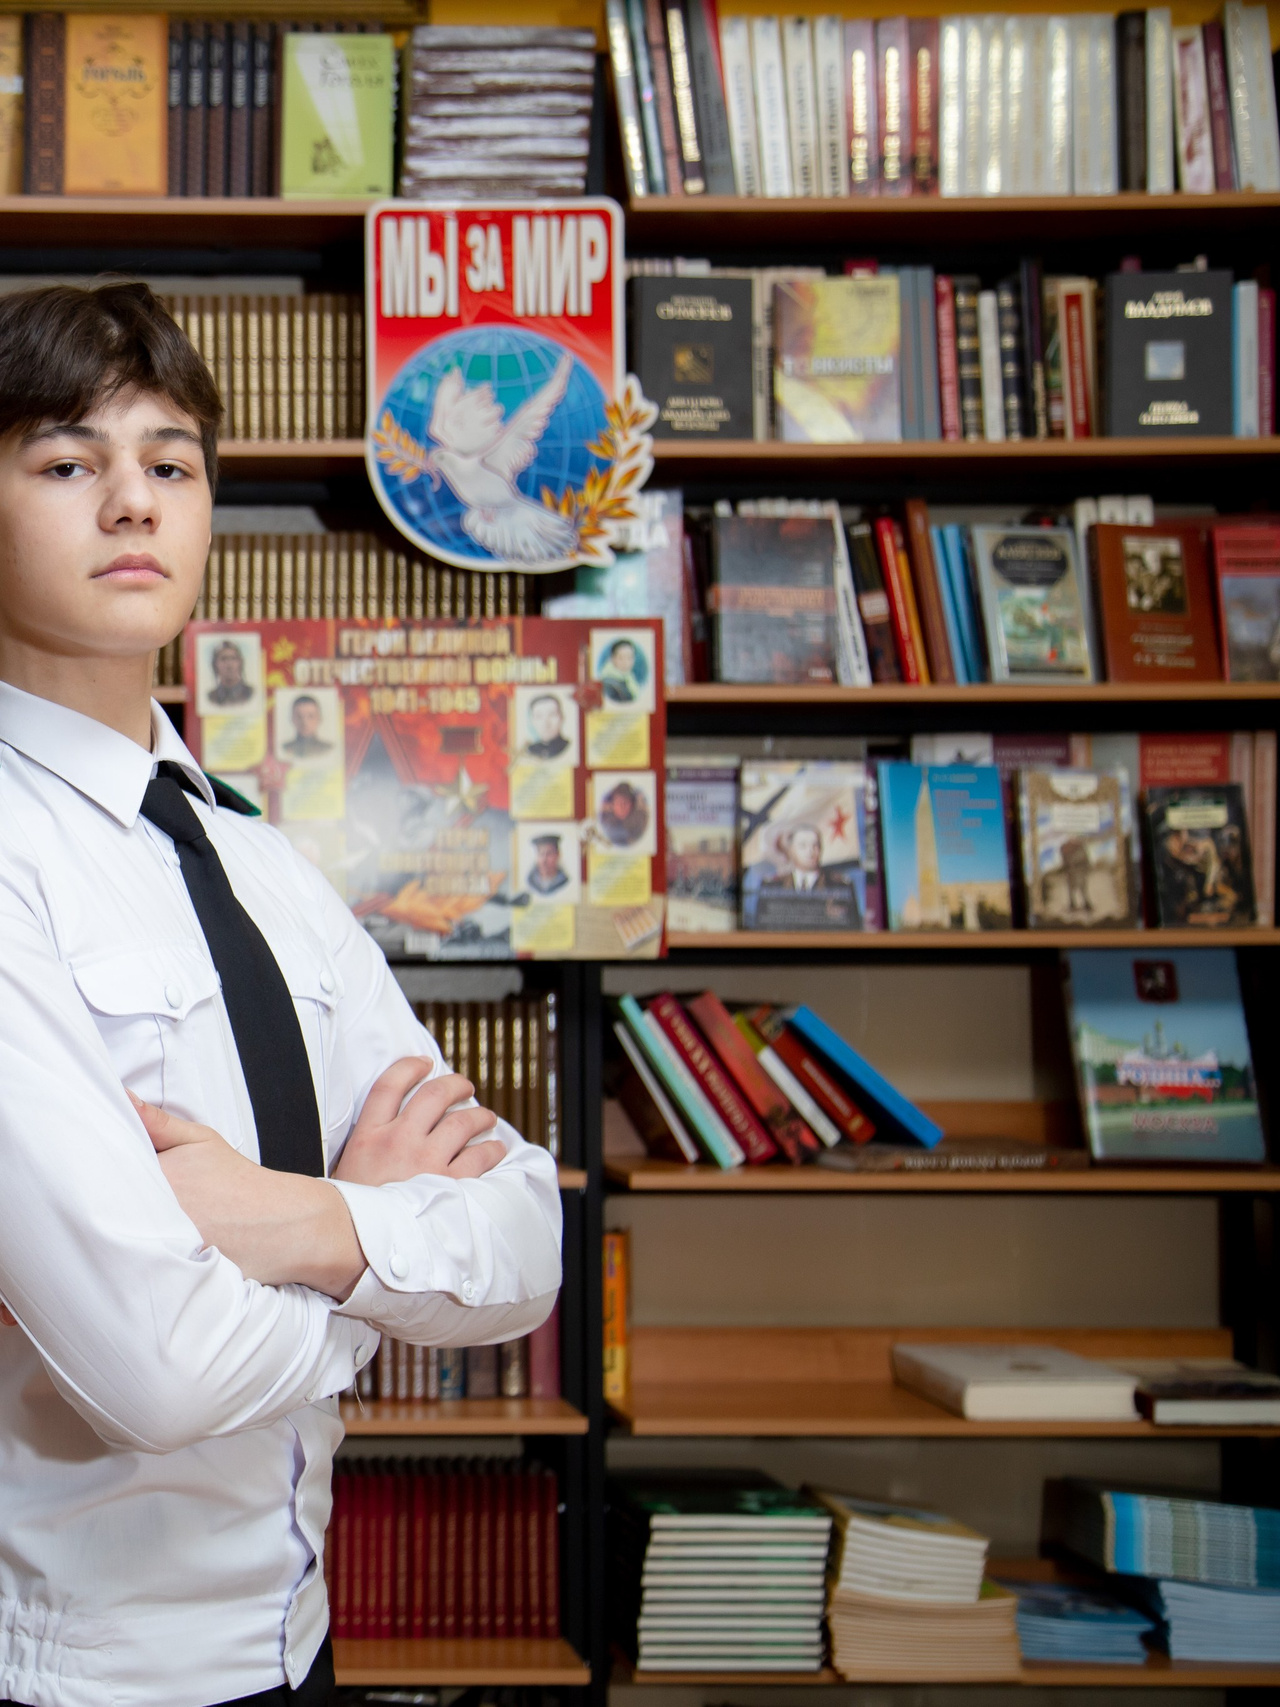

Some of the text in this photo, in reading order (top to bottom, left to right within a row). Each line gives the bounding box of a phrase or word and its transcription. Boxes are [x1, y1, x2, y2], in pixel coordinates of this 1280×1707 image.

[380, 214, 610, 318] МЫ ЗА МИР
[338, 626, 511, 656] ГЕРОИ ВЕЛИКОЙ
[293, 655, 559, 686] ОТЕЧЕСТВЕННОЙ ВОЙНЫ
